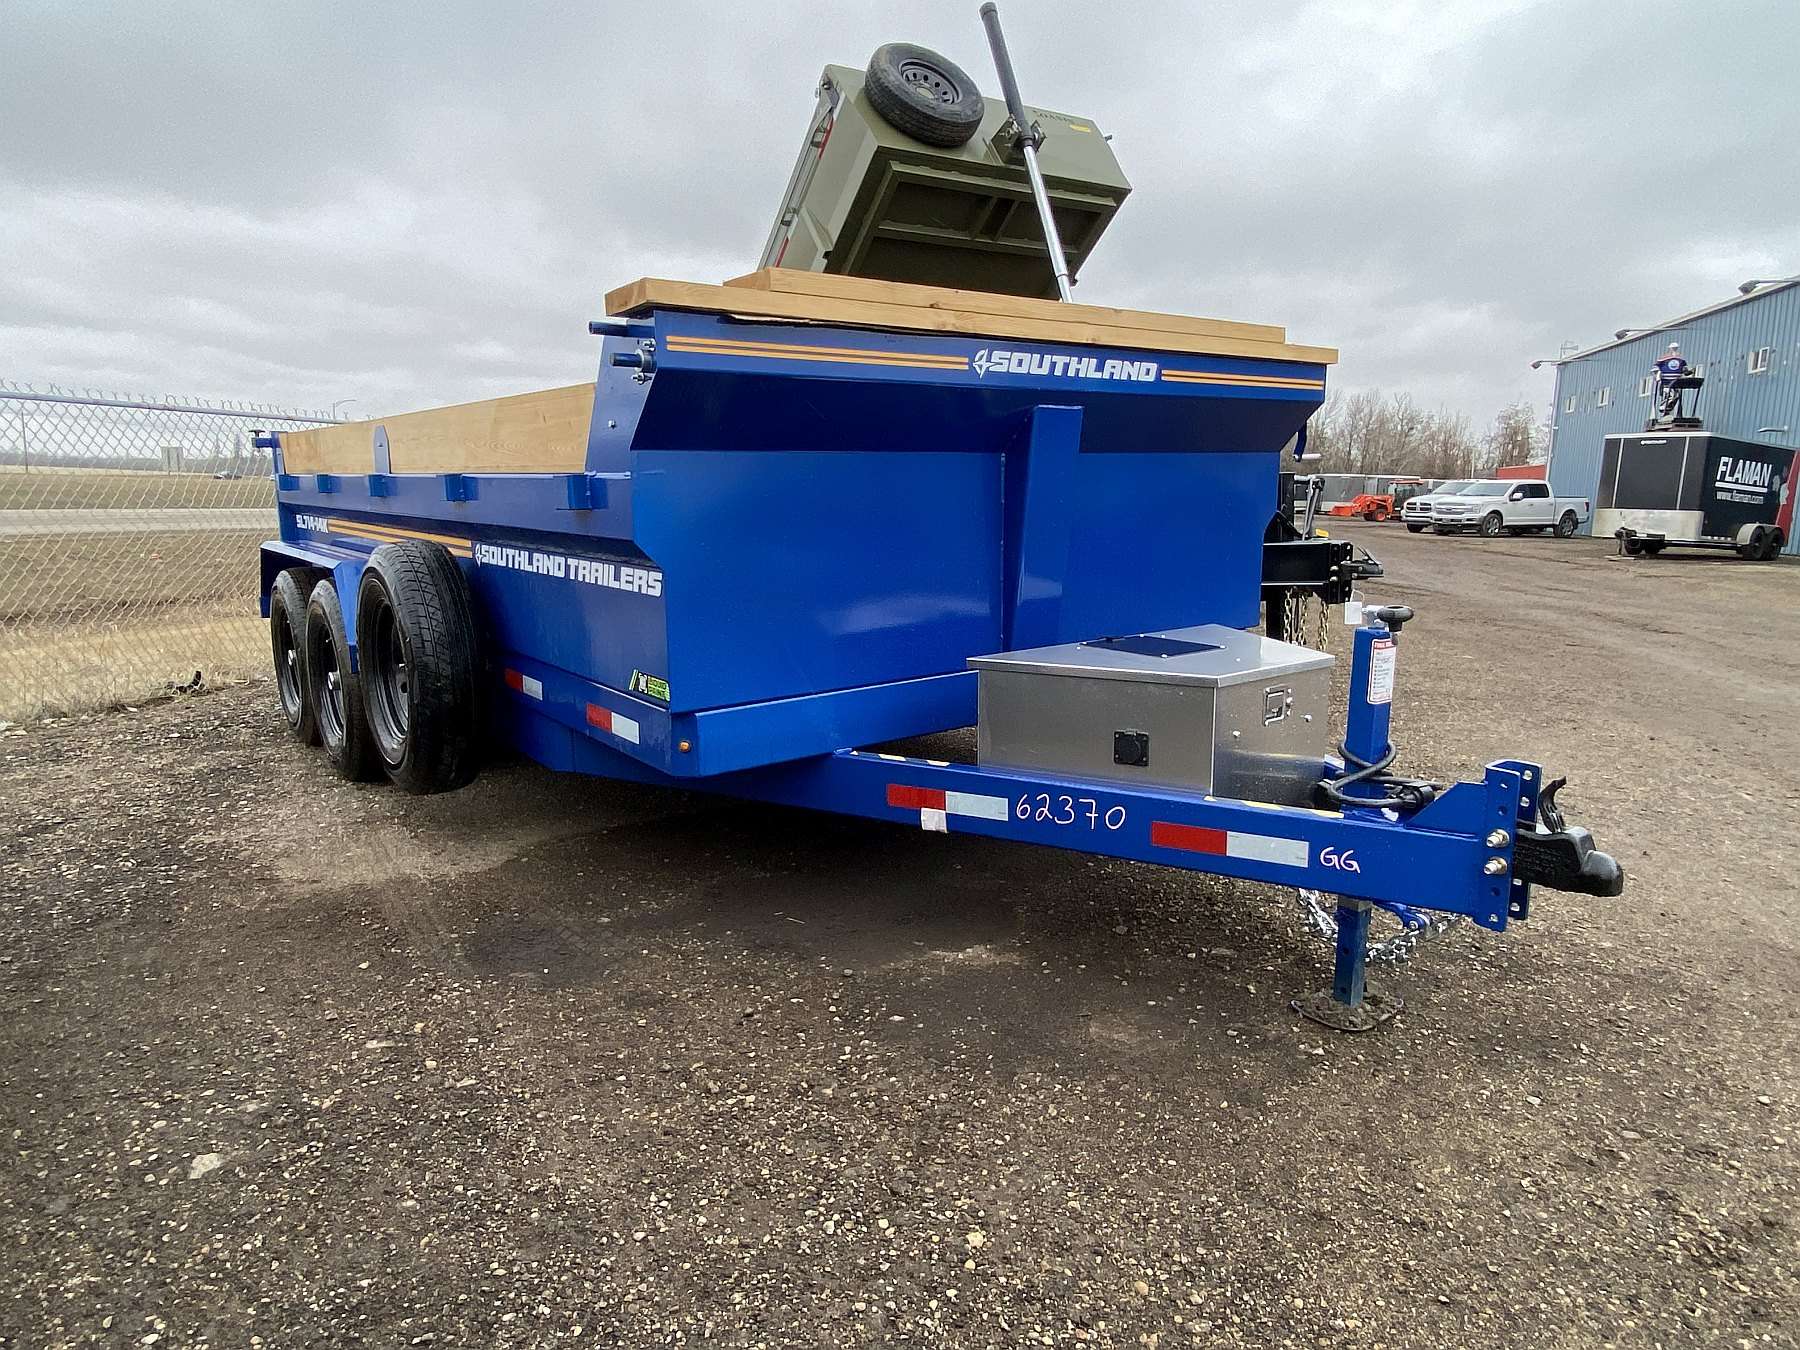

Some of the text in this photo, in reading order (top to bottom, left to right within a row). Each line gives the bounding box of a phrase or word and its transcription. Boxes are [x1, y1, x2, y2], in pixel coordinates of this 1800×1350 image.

[989, 350, 1158, 382] SOUTHLAND
[1716, 456, 1772, 486] FLAMAN
[481, 544, 663, 597] SOUTHLAND TRAILERS
[1016, 793, 1126, 830] 62370
[1320, 846, 1361, 874] GG
